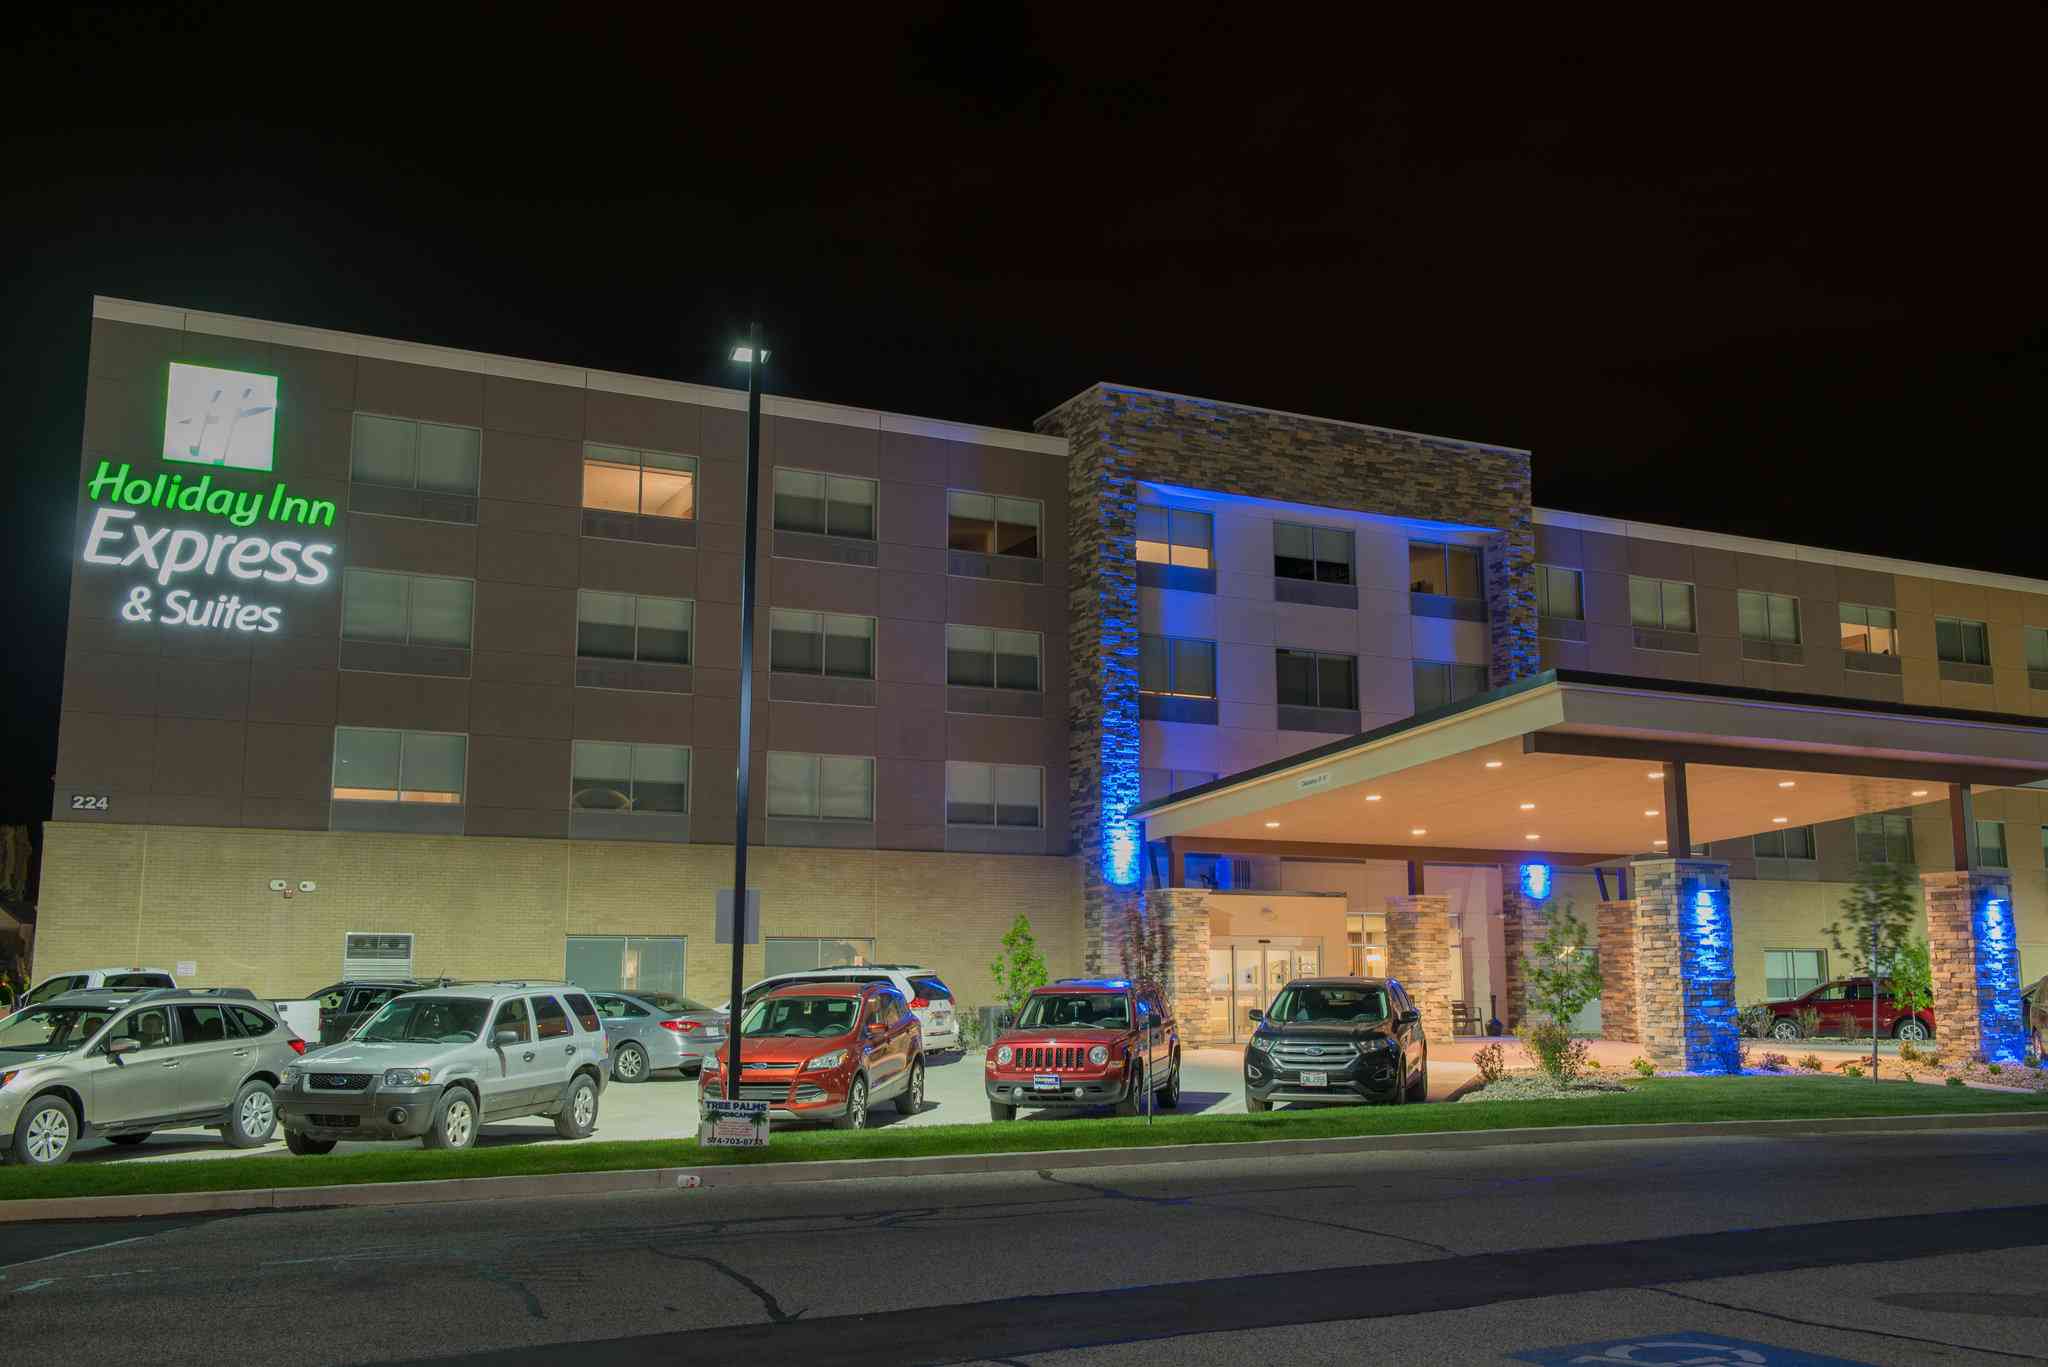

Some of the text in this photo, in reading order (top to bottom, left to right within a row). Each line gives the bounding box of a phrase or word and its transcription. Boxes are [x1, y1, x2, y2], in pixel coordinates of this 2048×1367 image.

[88, 461, 336, 527] Holiday Inn
[82, 506, 334, 586] Express
[121, 585, 283, 633] & Suites
[72, 796, 109, 810] 224
[733, 1102, 767, 1112] PALMS
